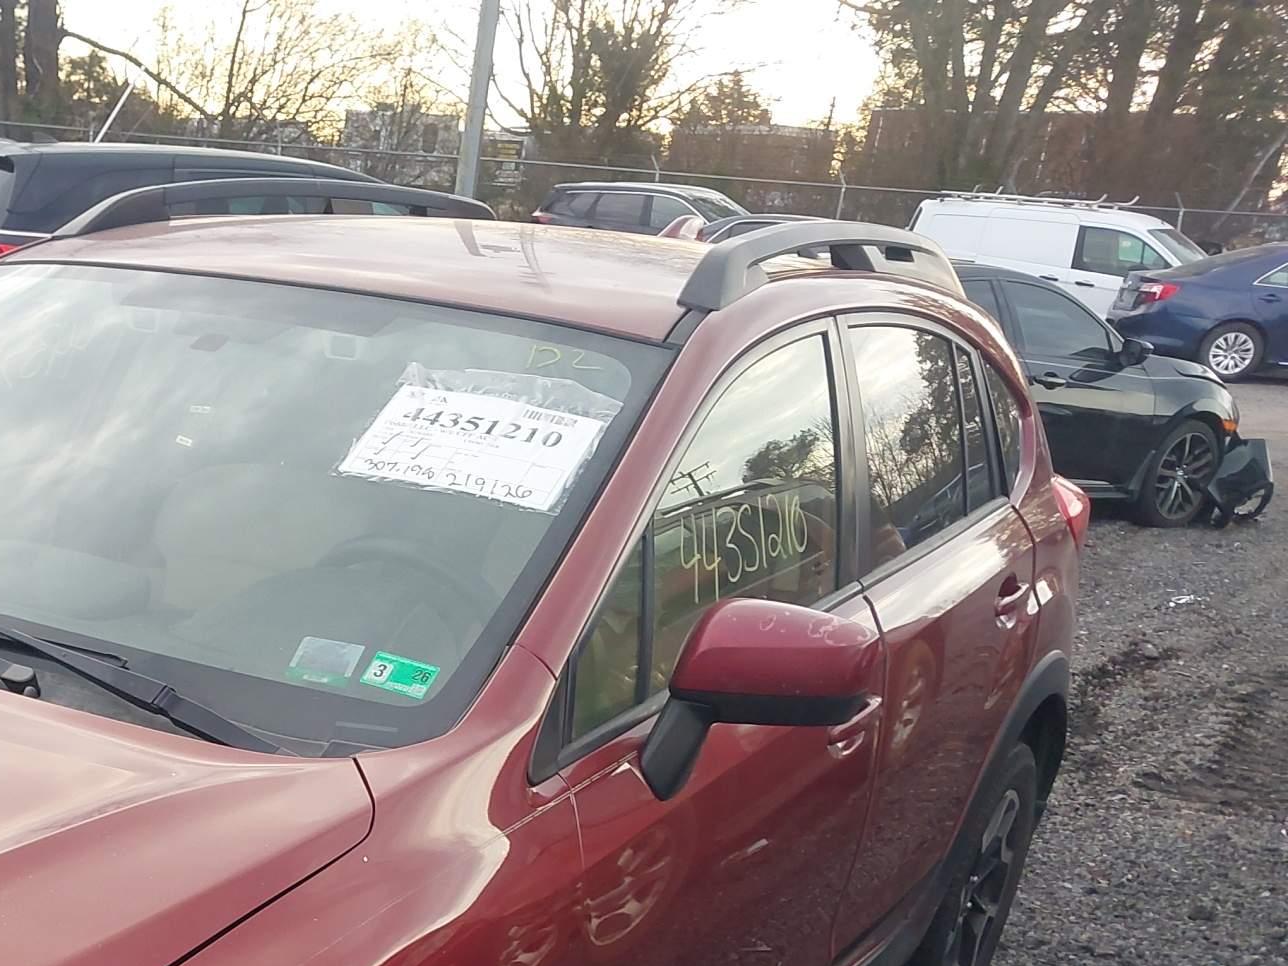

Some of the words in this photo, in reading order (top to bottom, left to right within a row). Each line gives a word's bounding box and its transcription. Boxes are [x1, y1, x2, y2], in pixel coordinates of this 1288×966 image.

[402, 407, 563, 448] 44351210
[680, 494, 808, 604] 44351210
[373, 664, 388, 678] 3
[411, 669, 433, 684] 26
